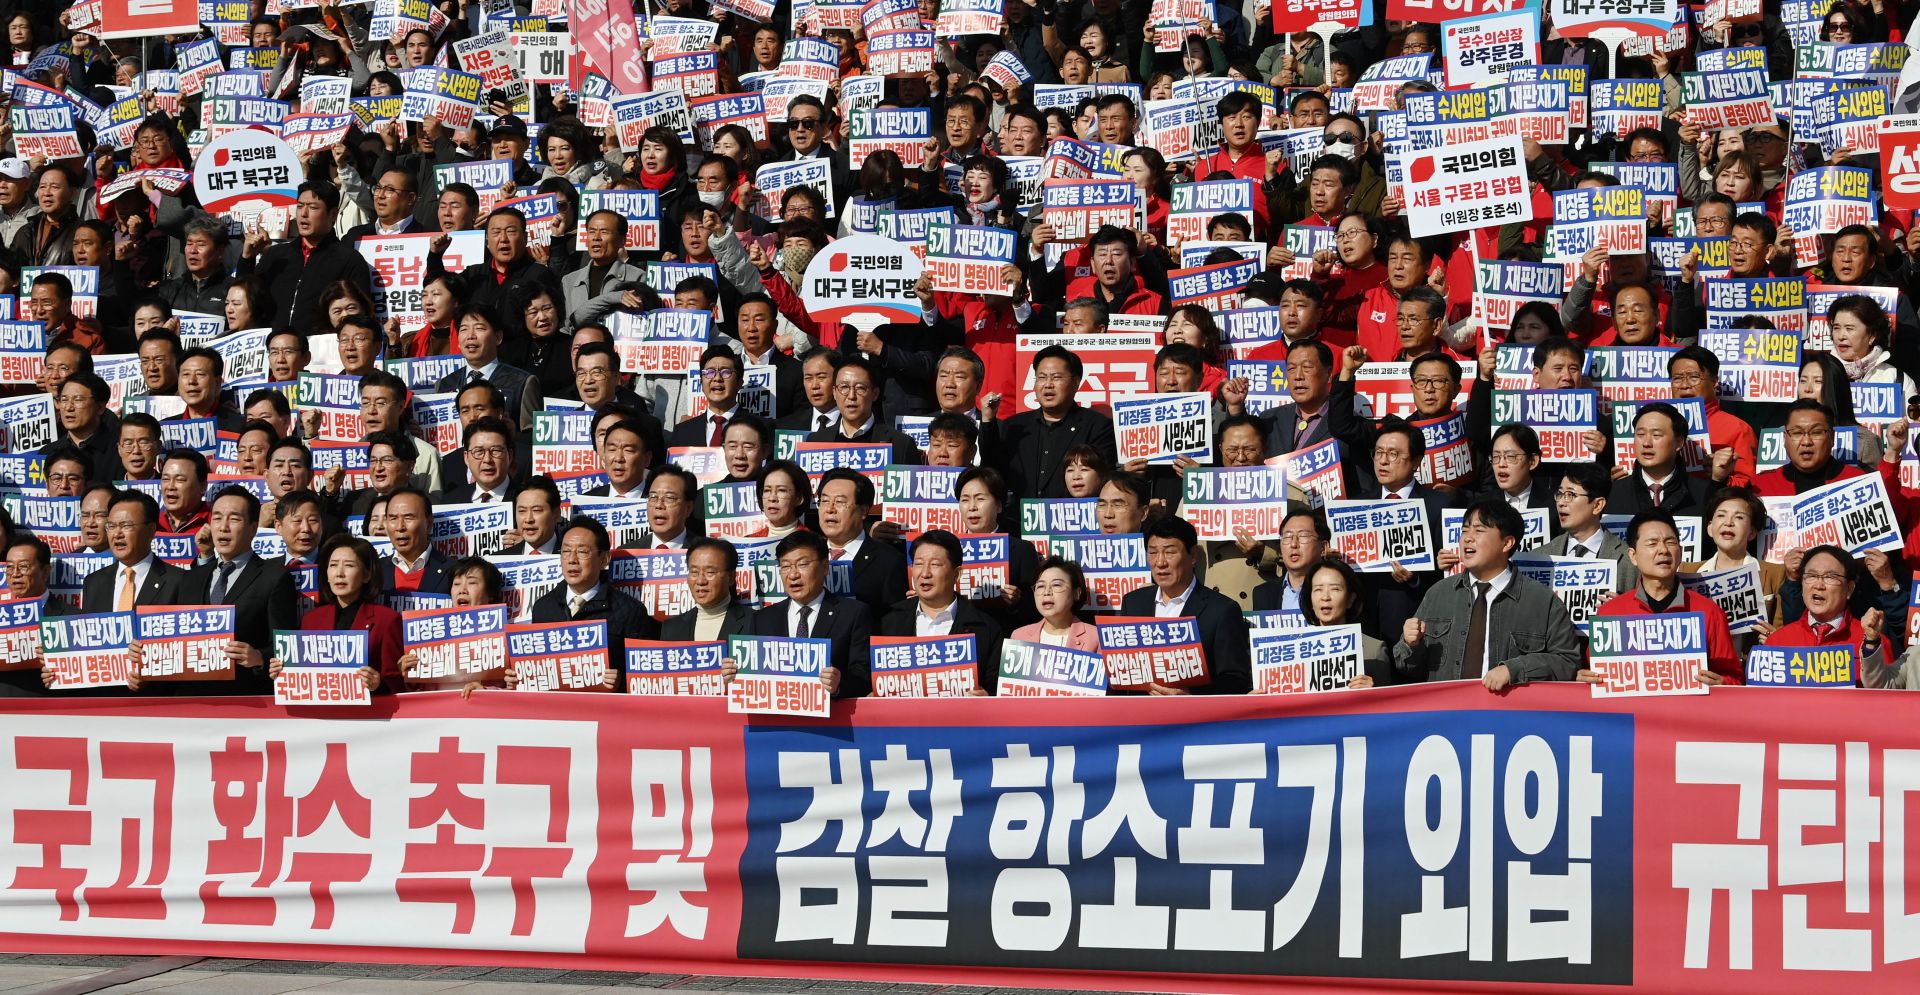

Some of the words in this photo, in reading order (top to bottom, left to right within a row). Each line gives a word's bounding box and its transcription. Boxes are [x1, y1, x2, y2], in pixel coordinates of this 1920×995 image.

[1318, 9, 1357, 22] 당원협의회
[1458, 25, 1480, 33] 국민의힘
[458, 32, 506, 54] 애국시민여러분!!
[521, 36, 557, 47] 국민의힘
[871, 32, 891, 49] 대장동
[895, 31, 911, 48] 항소
[915, 30, 932, 48] 포기
[1459, 28, 1523, 49] 보수의심장
[463, 50, 493, 72] 자유
[798, 41, 838, 66] 재판재개
[1460, 42, 1524, 66] 상주문경
[438, 75, 480, 101] 수사외압
[1489, 86, 1507, 113] 5개
[1510, 84, 1565, 111] 재판재개
[1613, 83, 1660, 108] 수사외압
[1709, 73, 1765, 99] 재판재개
[216, 100, 234, 121] 5개
[617, 105, 642, 123] 대장동
[644, 100, 663, 118] 항소
[665, 95, 684, 114] 포기
[1723, 103, 1773, 128] 명령이다
[1837, 89, 1886, 117] 수사외압
[12, 110, 27, 131] 5개
[30, 107, 72, 131] 재판재개
[853, 113, 872, 136] 5개
[877, 110, 927, 135] 재판재개
[43, 134, 78, 155] 명령이다
[231, 147, 276, 162] 국민의힘
[1442, 147, 1516, 174] 국민의힘
[208, 172, 237, 191] 대구
[241, 164, 289, 189] 북구갑
[1791, 172, 1816, 199] 대장동
[1820, 169, 1868, 197] 수사외압
[581, 194, 600, 217] 5개
[603, 193, 655, 217] 재판재개
[1047, 187, 1079, 205] 대장동
[1083, 186, 1104, 204] 항소
[1108, 182, 1131, 202] 포기
[1172, 191, 1195, 211] 5개
[1198, 186, 1250, 211] 재판재개
[1413, 188, 1441, 208] 서울
[1445, 181, 1488, 203] 구로갑
[1492, 176, 1522, 196] 당협
[1556, 194, 1589, 221] 대장동
[1593, 190, 1642, 216] 수사외압
[1441, 208, 1479, 226] (위원장
[1482, 202, 1522, 220] 호준석)
[929, 230, 951, 255] 5개
[955, 233, 1013, 258] 재판재개
[850, 255, 902, 271] 국민의힘
[814, 279, 847, 299] 대구
[1174, 277, 1207, 297] 대장동
[1210, 270, 1232, 290] 항소
[1709, 282, 1746, 308] 대장동
[1750, 280, 1803, 308] 수사외압
[1744, 333, 1797, 363] 수사외압
[300, 381, 321, 402] 5개
[1119, 410, 1152, 426] 대장동
[1155, 405, 1178, 422] 항소
[1181, 400, 1205, 417] 포기
[1495, 397, 1521, 423] 5개
[1526, 394, 1592, 423] 재판재개
[12, 421, 51, 453] 사망선고
[536, 415, 558, 442] 5개
[1120, 429, 1160, 455] 사법정의
[1163, 419, 1206, 453] 사망선고
[800, 450, 835, 472] 대장동
[838, 447, 861, 469] 항소
[865, 446, 889, 468] 포기
[1433, 451, 1473, 483] 특검하라
[886, 470, 909, 499] 5개
[1187, 470, 1213, 498] 5개
[1219, 468, 1283, 498] 재판재개
[24, 501, 81, 527] 재판재개
[708, 487, 733, 515] 5개
[1796, 504, 1824, 530] 대장동
[1828, 495, 1852, 515] 항소
[1854, 482, 1880, 505] 포기
[886, 507, 922, 533] 국민의
[1024, 504, 1046, 531] 5개
[1334, 515, 1367, 532] 대장동
[1371, 512, 1395, 530] 항소
[1397, 508, 1420, 526] 포기
[1841, 502, 1891, 545] 사망선고
[1050, 538, 1072, 565] 5개
[1080, 536, 1147, 573] 재판재개
[1382, 524, 1426, 557] 사망선고
[43, 622, 68, 649] 5개
[73, 617, 133, 647] 재판재개
[141, 618, 175, 638] 대장동
[178, 614, 201, 634] 항소
[205, 611, 230, 633] 포기
[407, 619, 445, 642] 대장동
[449, 615, 474, 635] 항소
[478, 610, 502, 632] 포기
[1142, 625, 1164, 645] 항소
[1168, 618, 1195, 643] 포기
[1593, 621, 1621, 652] 5개
[1626, 617, 1701, 650] 재판재개
[275, 634, 298, 662] 5개
[302, 634, 364, 664] 재판재개
[511, 634, 546, 655] 대장동
[548, 630, 574, 650] 항소
[577, 626, 602, 647] 포기
[875, 648, 912, 668] 대장동
[915, 645, 941, 665] 항소
[945, 639, 971, 662] 포기
[1257, 645, 1295, 665] 대장동
[1299, 640, 1326, 660] 항소
[1330, 634, 1356, 655] 포기
[141, 645, 184, 676] 외압실체
[458, 637, 505, 673] 특검하라
[629, 650, 664, 670] 대장동
[667, 648, 692, 668] 항소
[696, 647, 722, 668] 포기
[731, 642, 758, 672] 5개
[763, 640, 827, 671] 재판재개
[1002, 645, 1031, 672] 5개
[1037, 647, 1105, 685] 재판재개
[1152, 647, 1203, 683] 특검하라
[1748, 650, 1786, 683] 대장동
[1789, 650, 1851, 683] 수사외압
[515, 661, 558, 690] 외압실체
[559, 655, 605, 688] 특검하라
[1310, 653, 1357, 690] 사망선고
[1594, 661, 1638, 692] 국민의
[277, 672, 313, 700] 국민의
[317, 672, 365, 700] 명령이다
[731, 679, 772, 710] 국민의
[776, 683, 826, 712] 명령이다
[5, 736, 174, 921] 국고
[199, 736, 372, 930] 환수
[395, 736, 573, 936] 촉구
[624, 747, 713, 940] 및
[775, 744, 963, 948] 검찰
[988, 744, 1366, 959] 항소포기
[1400, 734, 1602, 964] 외압
